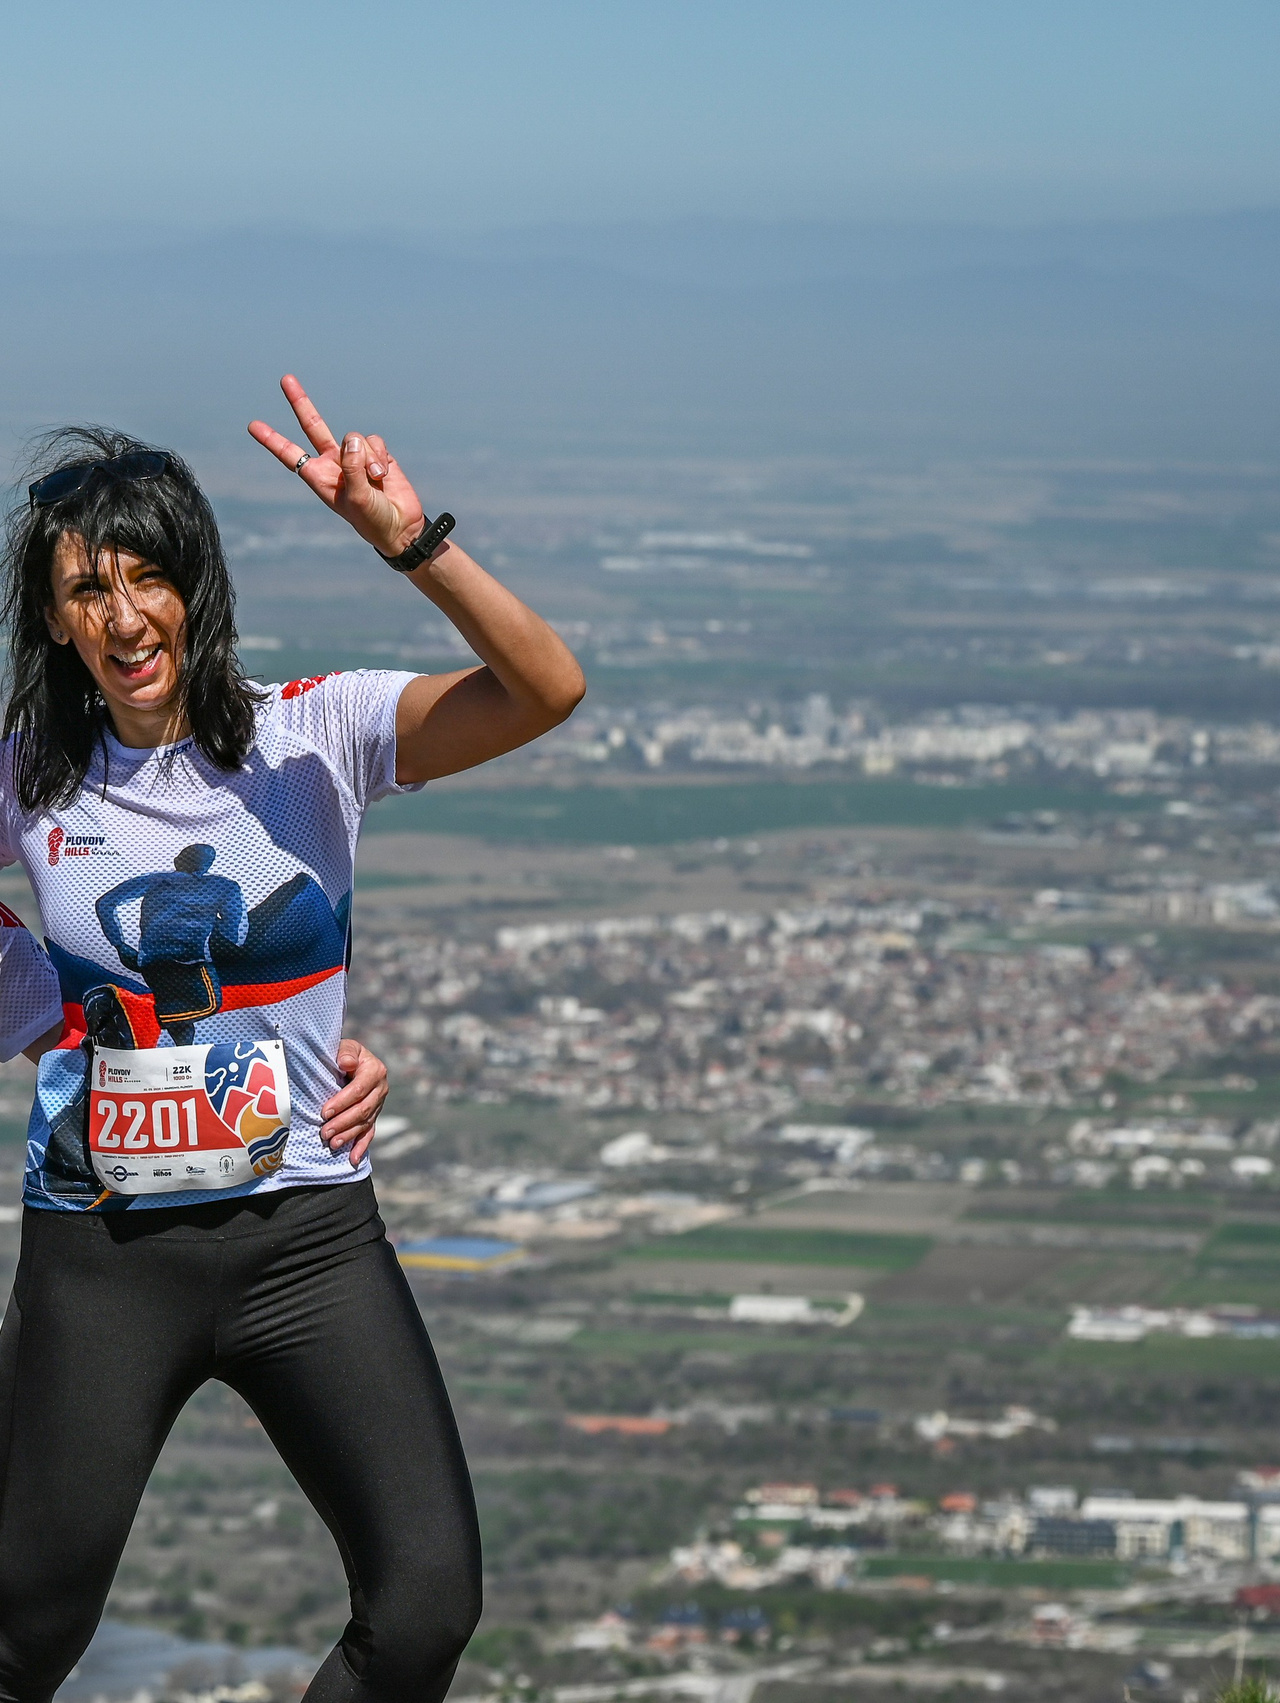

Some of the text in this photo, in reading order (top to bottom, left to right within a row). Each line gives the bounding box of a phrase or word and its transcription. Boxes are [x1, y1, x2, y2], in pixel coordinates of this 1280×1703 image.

[164, 741, 193, 758] EVERY
[65, 836, 105, 846] PLOVDIV
[64, 847, 90, 856] HILLS
[108, 1068, 131, 1076] PLOVDIV
[172, 1065, 192, 1075] 22K
[97, 1097, 199, 1149] 2201
